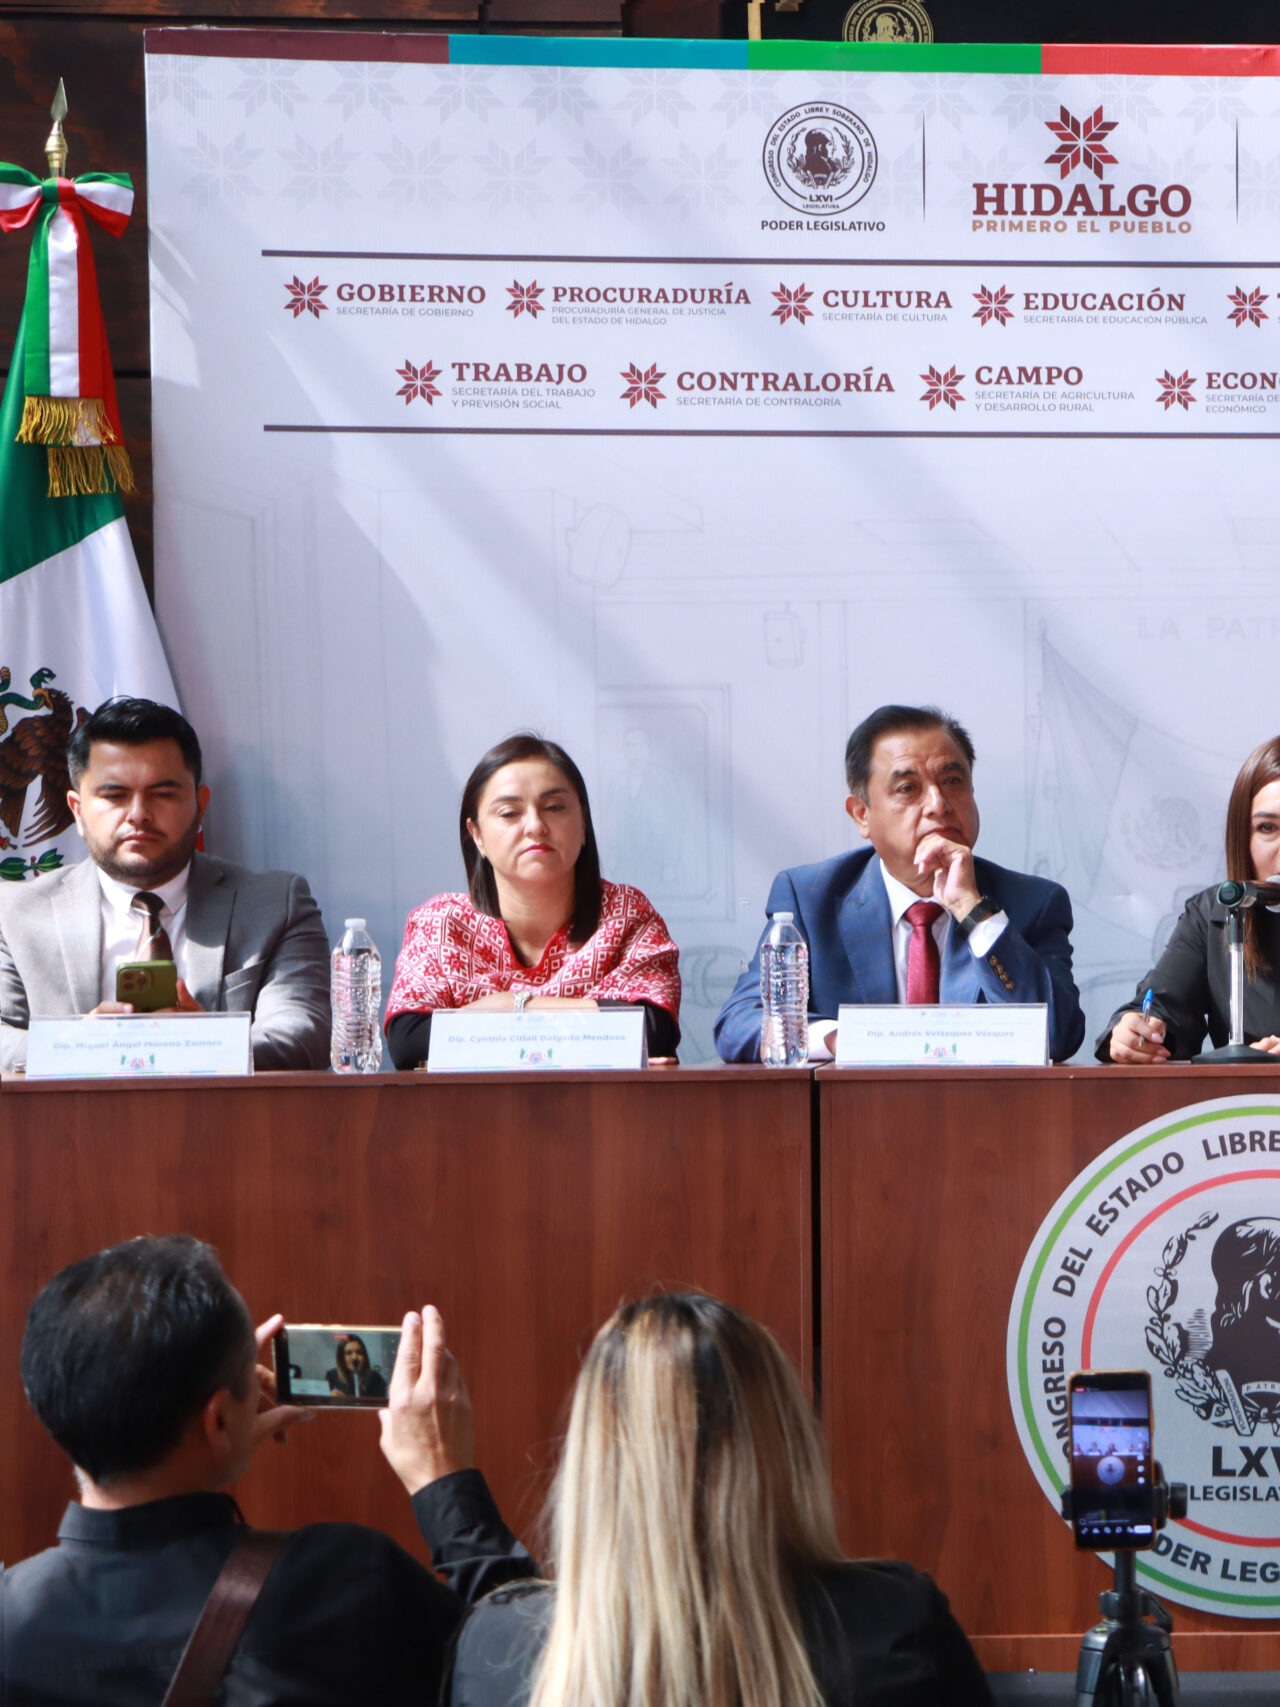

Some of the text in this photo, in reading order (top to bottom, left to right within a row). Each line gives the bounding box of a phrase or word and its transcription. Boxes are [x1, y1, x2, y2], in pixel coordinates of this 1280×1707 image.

[770, 134, 780, 146] DEL
[778, 112, 801, 132] ESTADO
[832, 109, 865, 135] SOBERANO
[863, 138, 871, 147] DE
[809, 194, 833, 202] LXVI
[972, 183, 1192, 218] HIDALGO
[761, 220, 886, 232] PODER LEGISLATIVO
[972, 219, 1192, 234] PRIMERO EL PUEBLO
[336, 283, 486, 304] GOBIERNO
[553, 282, 751, 304] PROCURADURÍA
[822, 290, 952, 308] CULTURA
[1024, 287, 1186, 311] EDUCACIÓN
[336, 306, 474, 318] SECRETARÍA DE GOBIERNO
[552, 306, 726, 316] PROCURADURÍA GENERAL DE JUSTICIA
[822, 312, 948, 322] SECRETARÍA DE CULTURA
[552, 316, 667, 326] DEL ESTADO DE HIDALGO
[1023, 314, 1208, 325] SECRETARÍA DE EDUCACIÓN PÚBLICA
[451, 362, 587, 386] TRABAJO
[677, 366, 895, 392] CONTRALORÍA
[975, 366, 1083, 386] CAMPO
[452, 387, 596, 398] SECRETARÍA DEL TRABAJO
[975, 390, 1135, 400] SECRETARÍA DE AGRICULTURA
[1206, 392, 1265, 402] SECRETARÍA
[1266, 394, 1280, 403] DE
[452, 398, 562, 409] Y PREVISIÓN SOCIAL
[676, 396, 842, 407] SECRETARÍA DE CONTRALORÍA
[974, 402, 1094, 412] Y DESARROLLO RURAL
[1206, 404, 1267, 414] ECONÓMICO
[1053, 1245, 1093, 1297] DEL
[1085, 1151, 1184, 1236] ESTADO
[1151, 1533, 1212, 1575] DER
